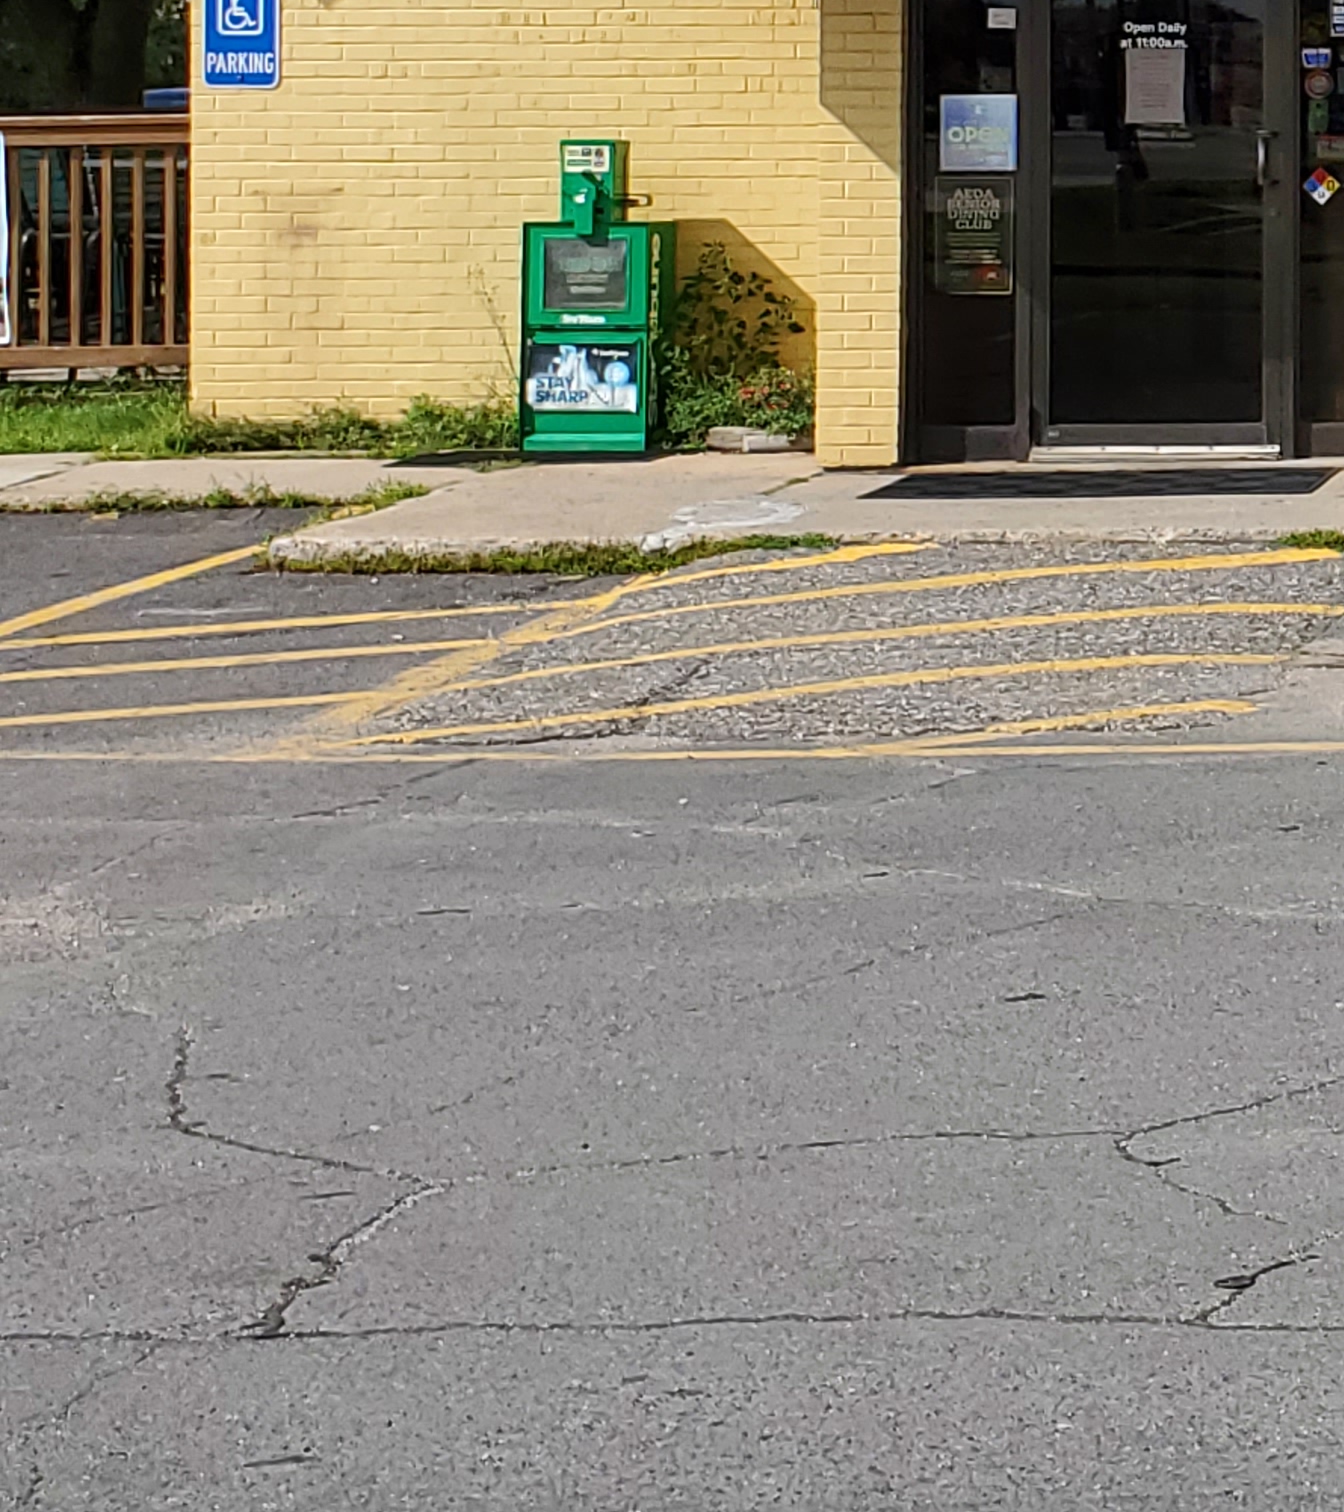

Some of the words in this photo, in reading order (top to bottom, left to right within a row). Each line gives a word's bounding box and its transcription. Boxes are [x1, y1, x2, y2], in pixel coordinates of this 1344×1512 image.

[1122, 21, 1155, 35] Open
[1157, 21, 1187, 35] Daily
[1119, 37, 1133, 49] at
[206, 51, 275, 74] PARKING
[535, 375, 575, 389] STAY
[535, 390, 589, 403] SHARP
